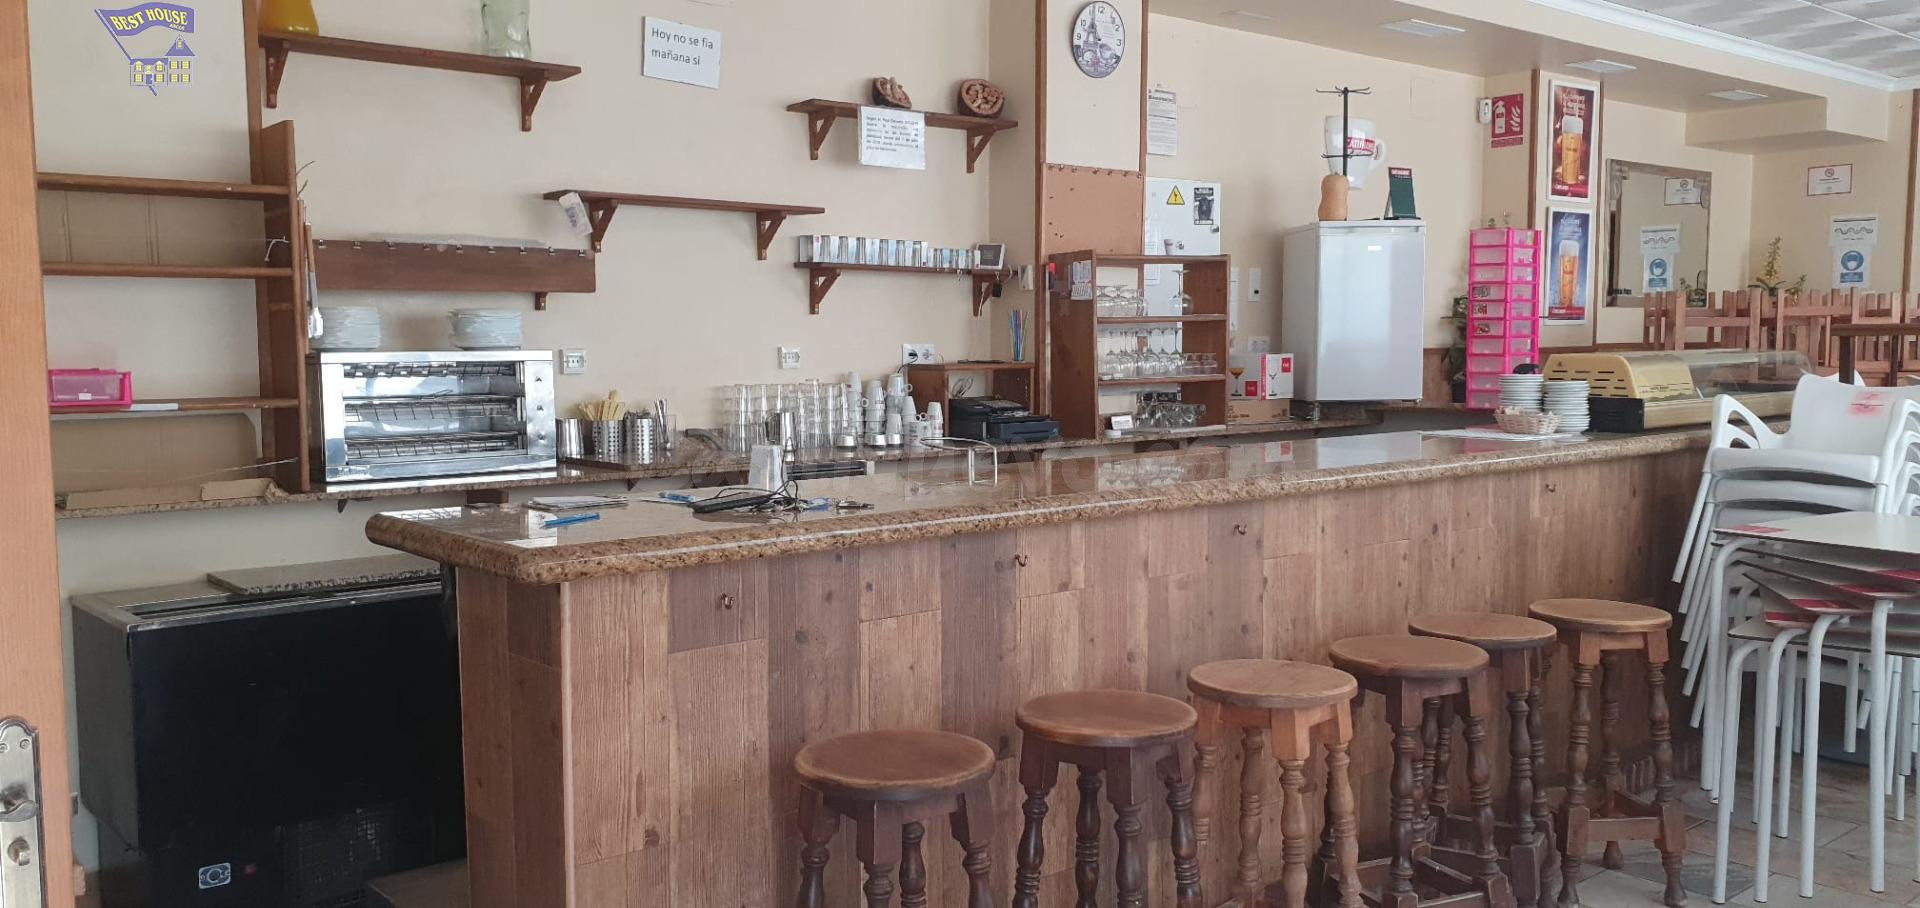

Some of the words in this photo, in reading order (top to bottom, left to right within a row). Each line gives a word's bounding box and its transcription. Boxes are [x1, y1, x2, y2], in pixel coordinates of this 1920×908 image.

[1097, 6, 1105, 14] 12
[651, 27, 672, 42] Hoy
[673, 34, 687, 44] no
[688, 37, 699, 46] se
[702, 37, 714, 49] fia
[1076, 32, 1082, 41] 9
[651, 48, 691, 64] mañana
